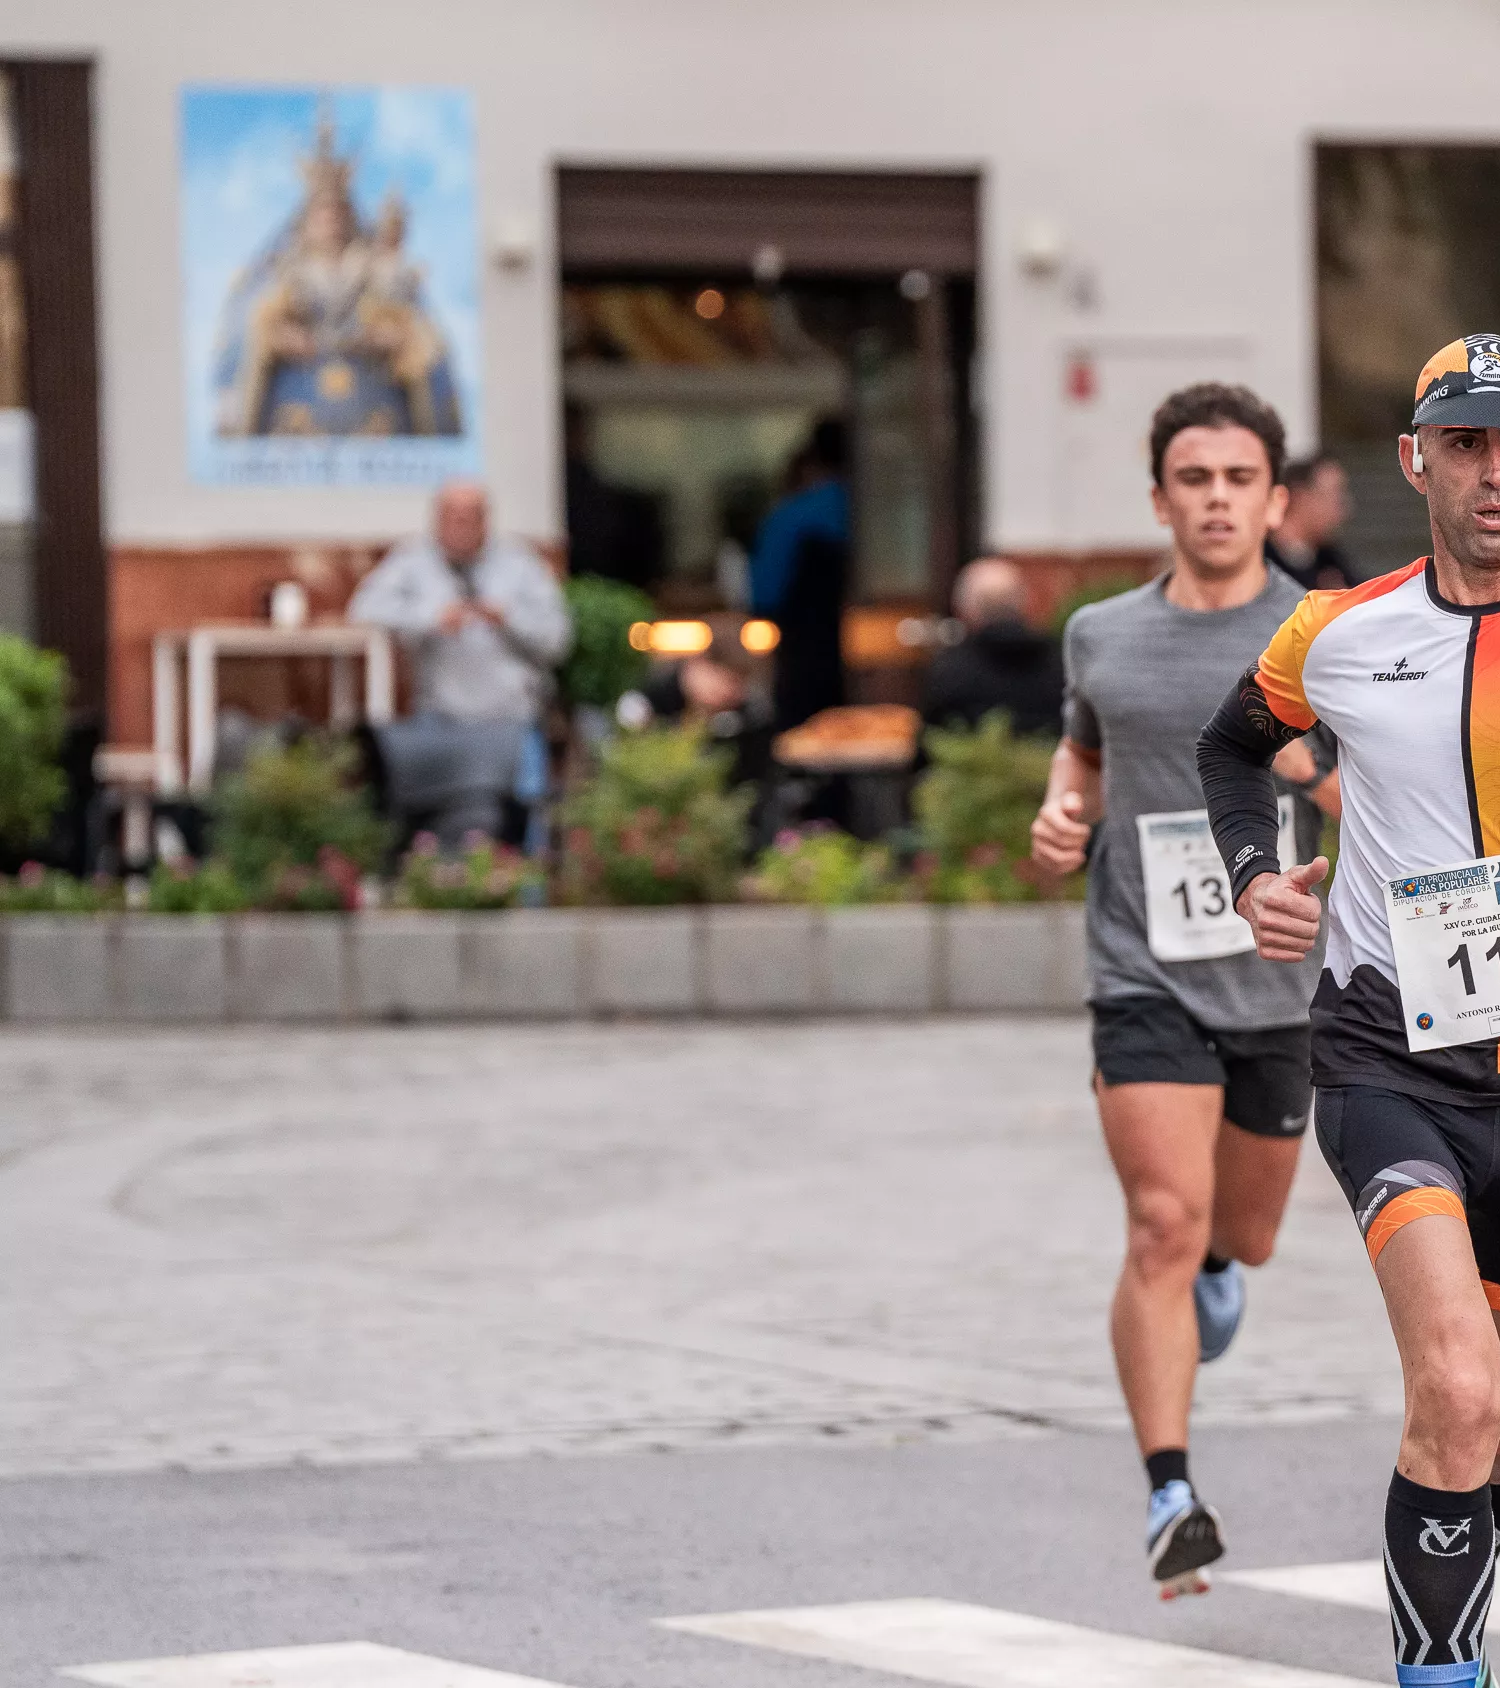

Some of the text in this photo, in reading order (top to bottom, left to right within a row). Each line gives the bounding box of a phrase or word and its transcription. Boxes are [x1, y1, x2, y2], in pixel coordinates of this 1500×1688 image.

[1372, 670, 1429, 682] TEAMERGY
[1427, 869, 1475, 884] PROVINCIAL
[1477, 865, 1489, 876] DE
[1440, 875, 1490, 891] POPULARES
[1171, 875, 1226, 919] 13
[1393, 893, 1438, 907] DIPUTACIÓN
[1455, 884, 1492, 897] CÓRDOBA
[1444, 921, 1459, 930] XXV
[1461, 930, 1477, 938] POR
[1456, 1006, 1493, 1020] ANTONIO
